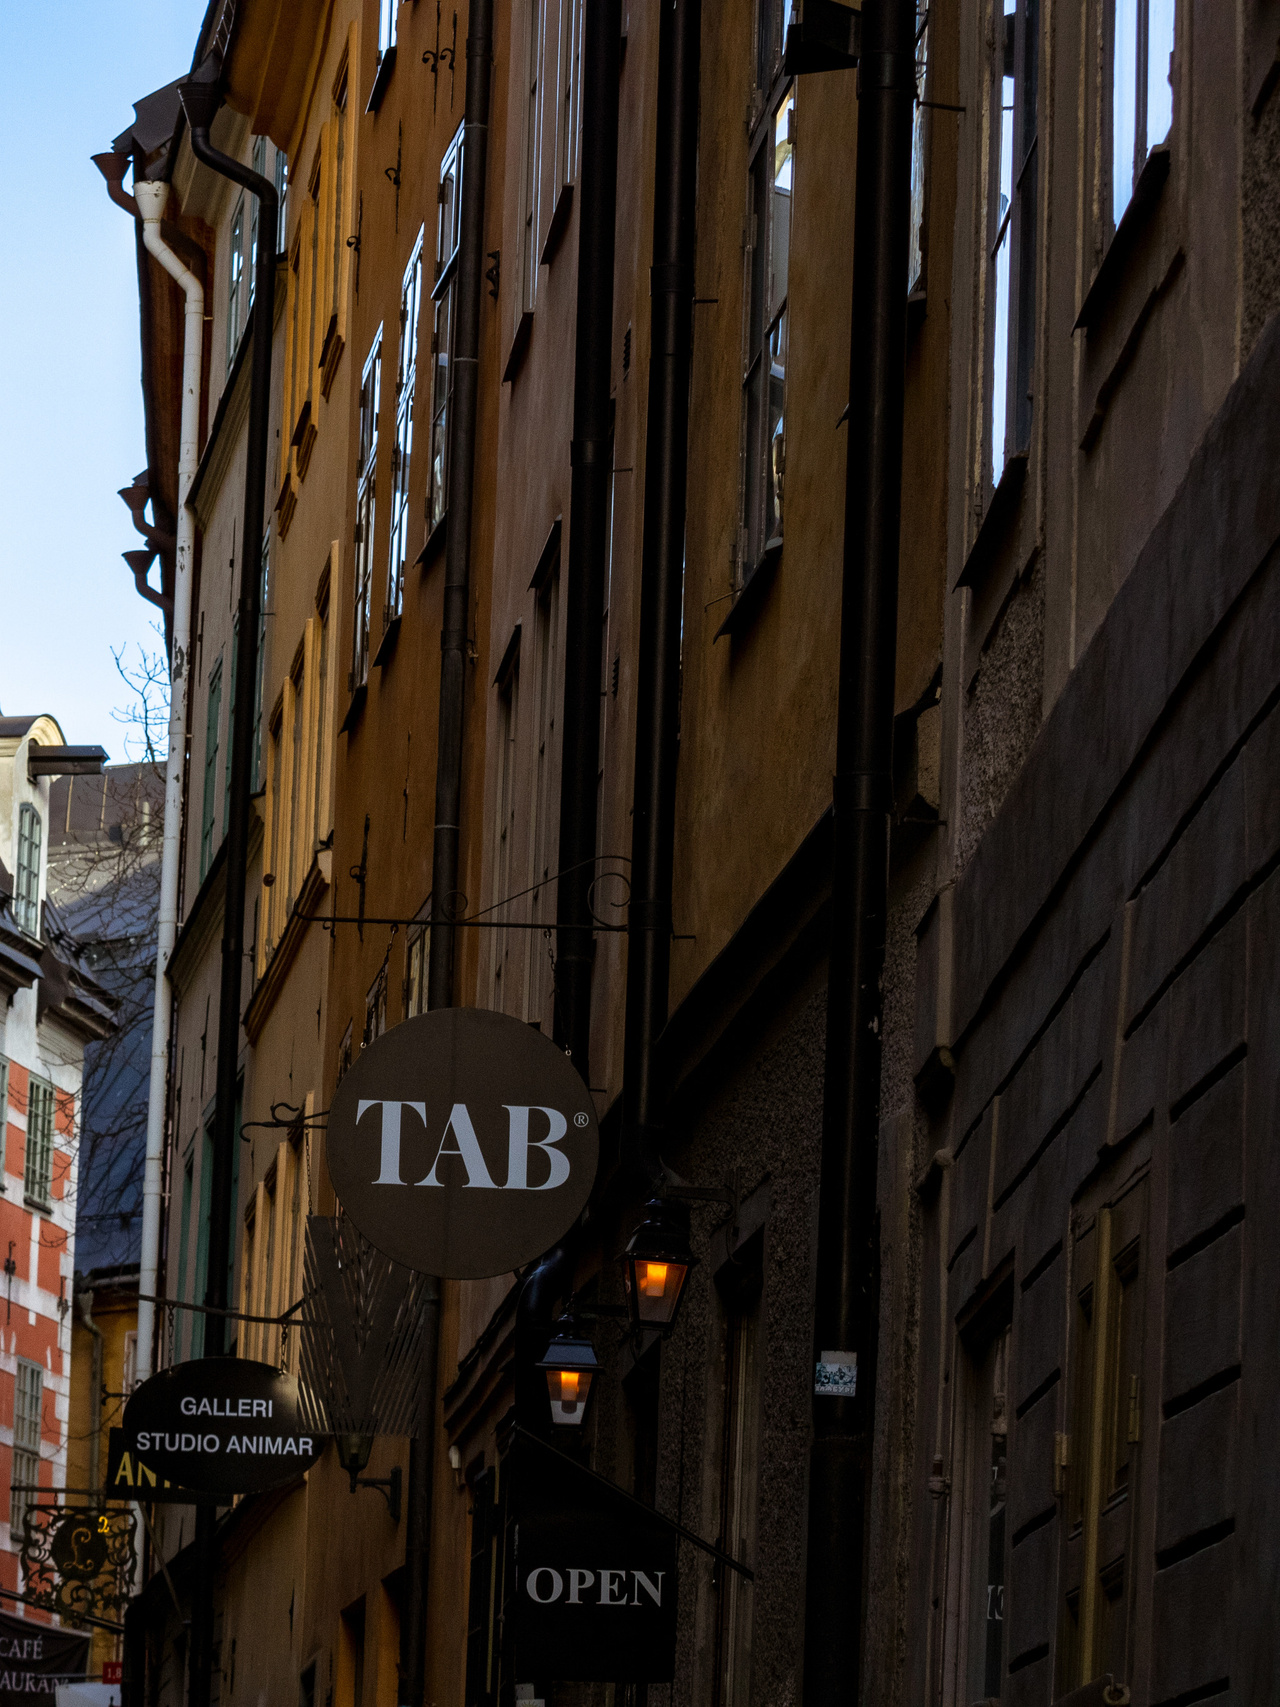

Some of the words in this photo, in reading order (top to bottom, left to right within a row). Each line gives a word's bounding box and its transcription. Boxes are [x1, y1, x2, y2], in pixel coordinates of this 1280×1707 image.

[180, 1396, 273, 1419] GALLERI
[136, 1431, 220, 1453] STUDIO
[225, 1434, 314, 1456] ANIMAR
[114, 1450, 173, 1489] AN
[525, 1567, 667, 1607] OPEN
